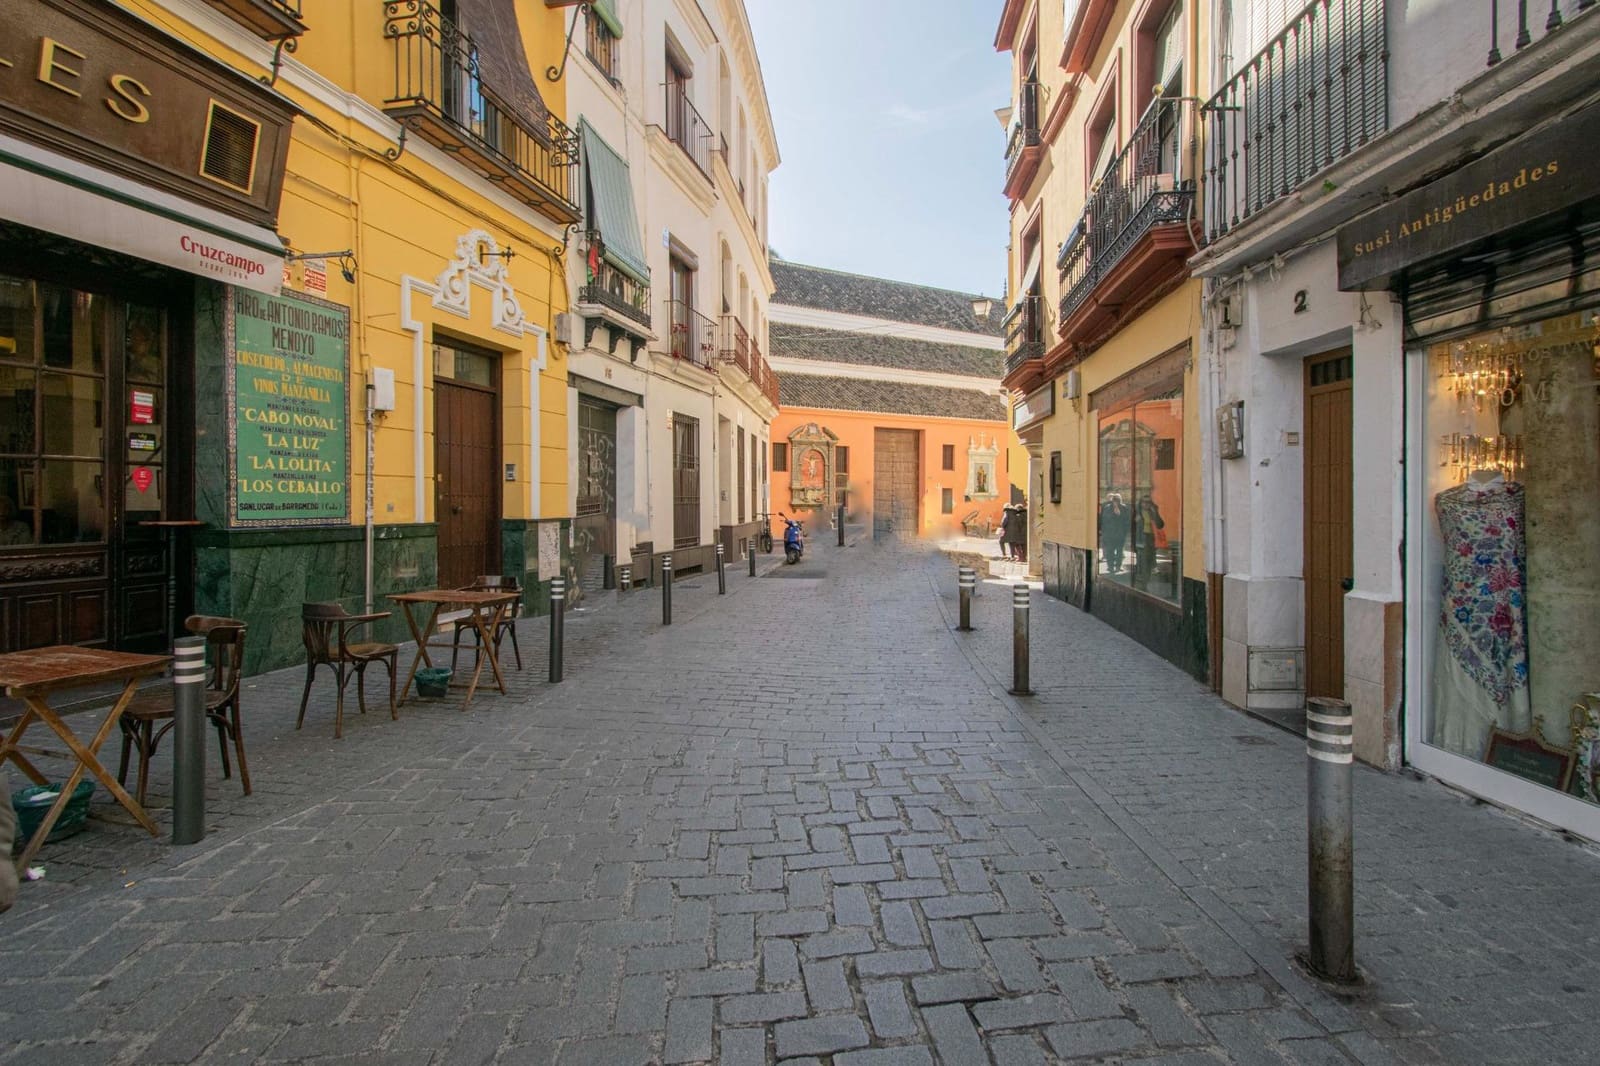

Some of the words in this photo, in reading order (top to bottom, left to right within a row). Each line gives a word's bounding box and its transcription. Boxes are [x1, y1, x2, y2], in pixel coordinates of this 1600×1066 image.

[0, 36, 152, 123] ES
[1353, 229, 1392, 257] Susi
[1398, 159, 1560, 240] Antigüedades
[180, 235, 265, 276] Cruzcampo
[267, 300, 311, 331] ANTONIO
[311, 312, 344, 339] RAMOS
[1294, 290, 1306, 314] 2
[272, 325, 315, 356] MENOYO
[253, 376, 279, 395] VINOS
[281, 381, 331, 403] MANZANILLA
